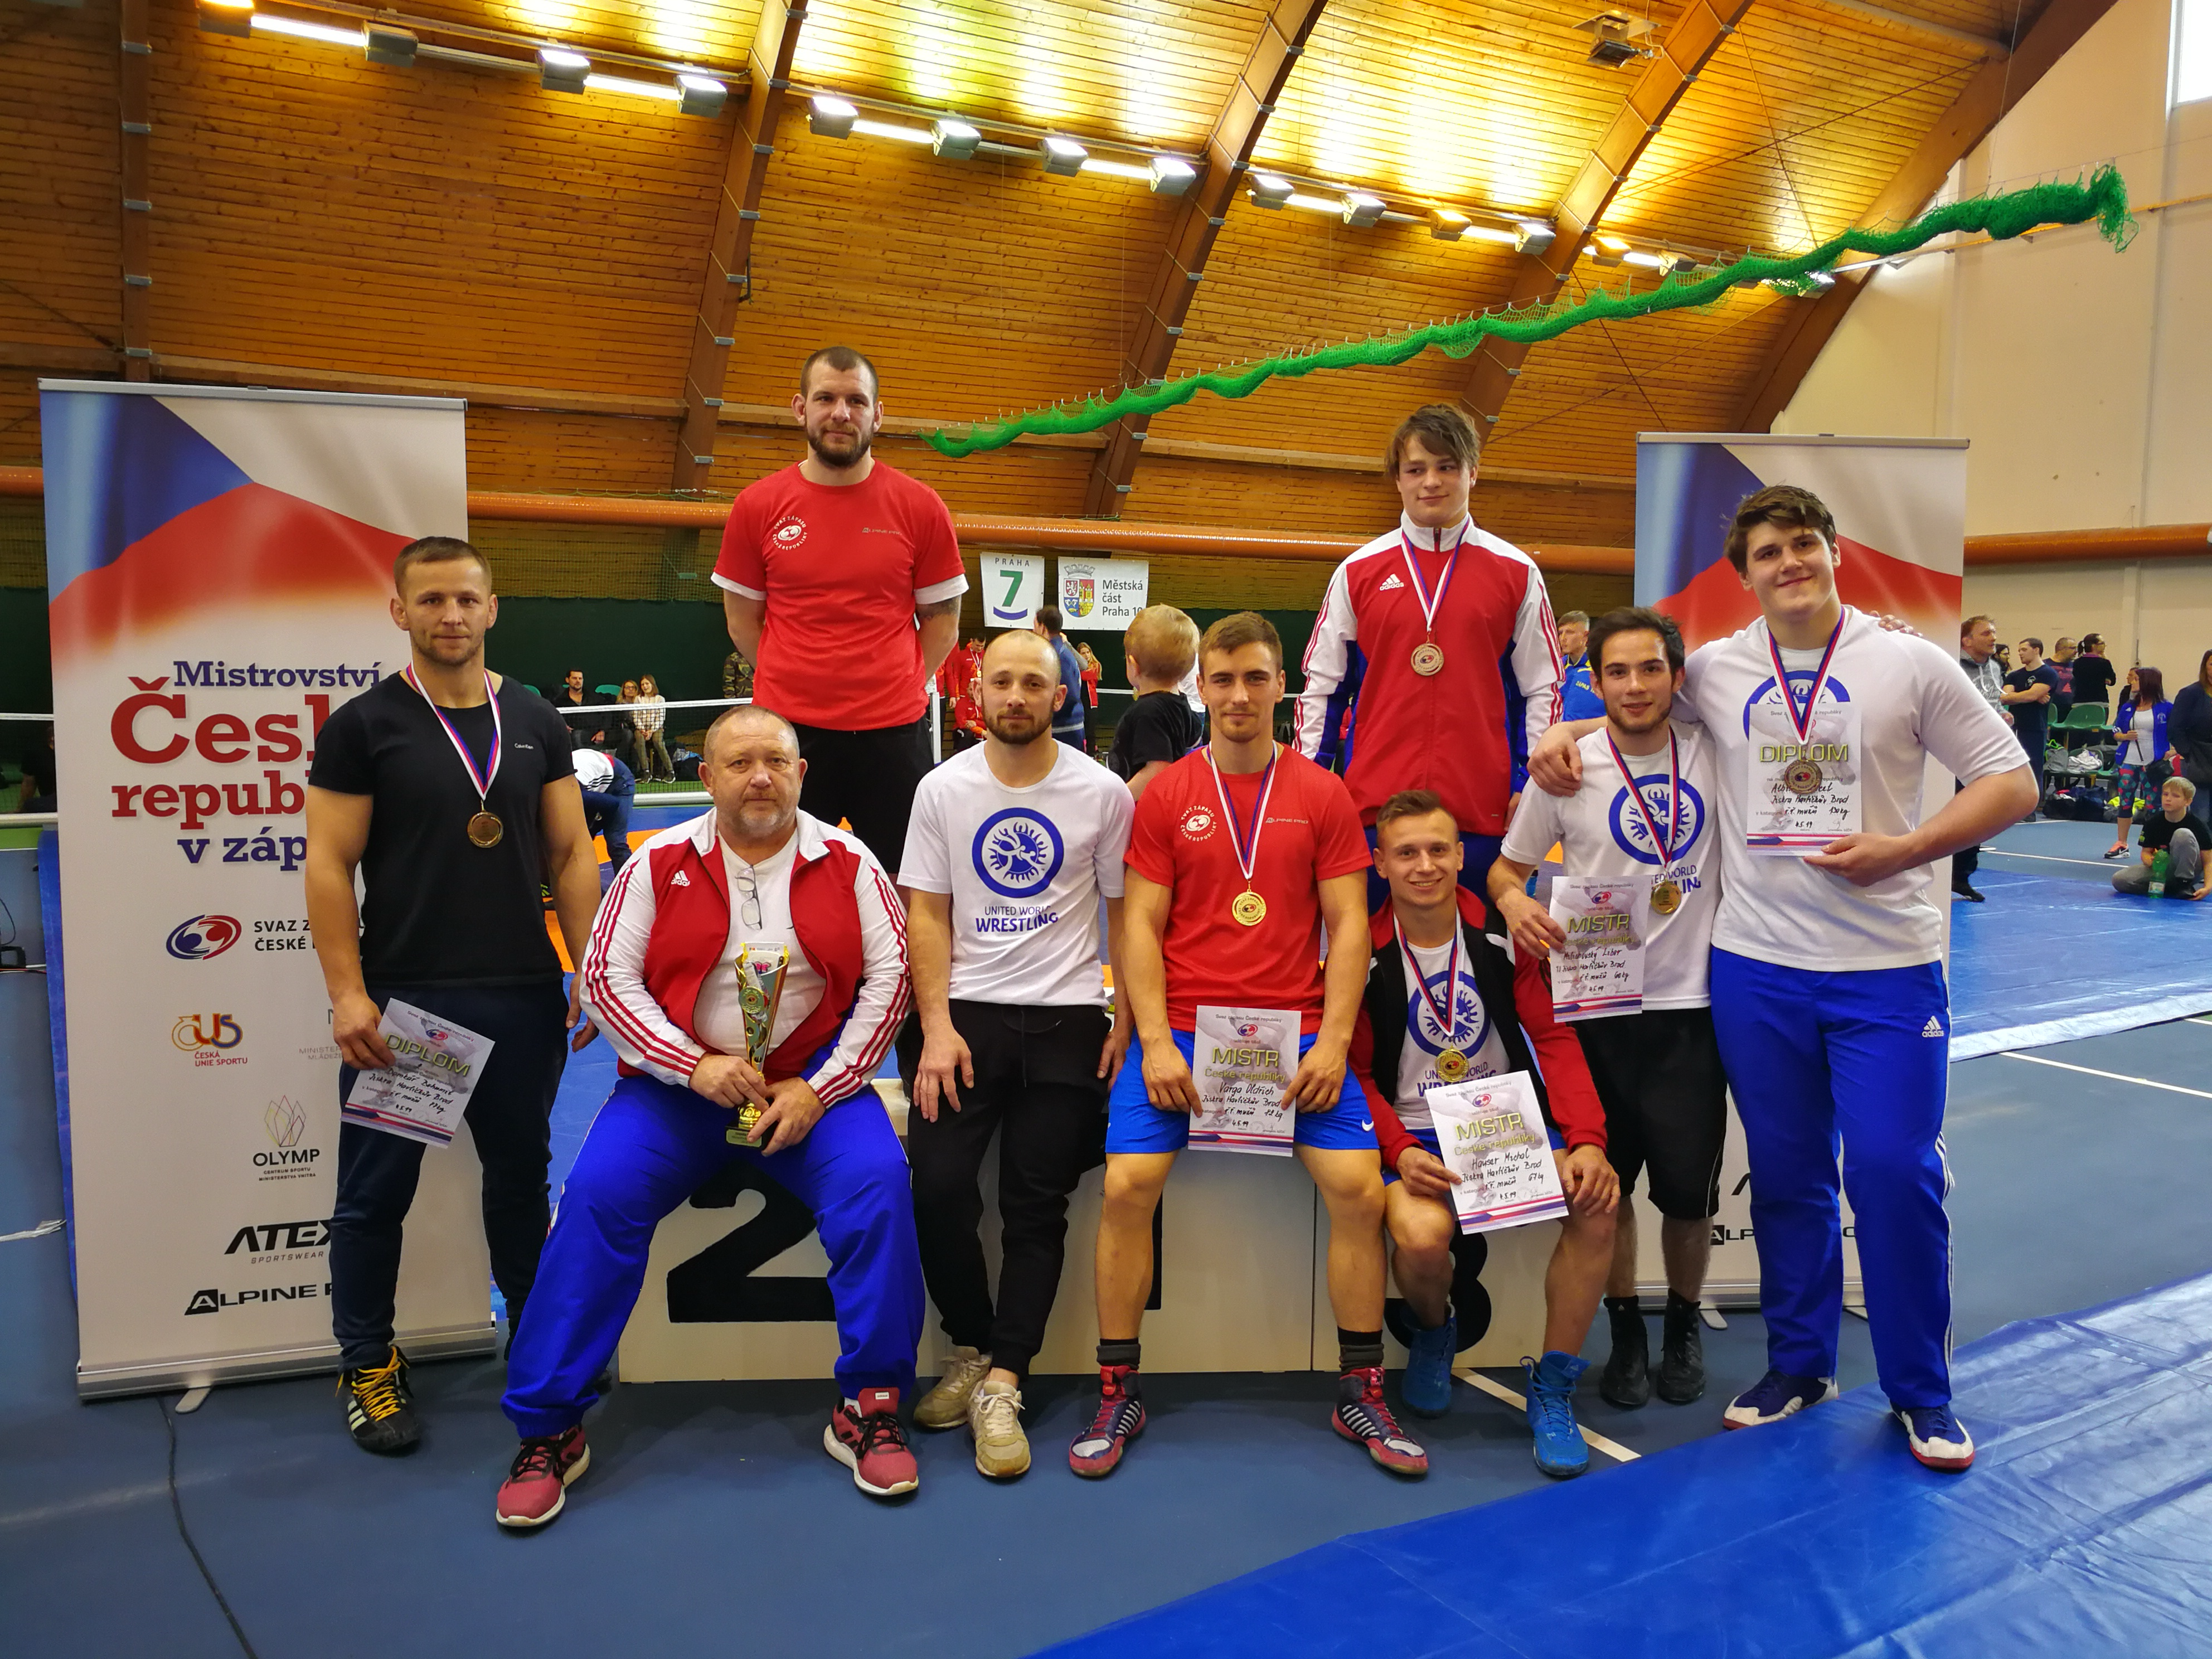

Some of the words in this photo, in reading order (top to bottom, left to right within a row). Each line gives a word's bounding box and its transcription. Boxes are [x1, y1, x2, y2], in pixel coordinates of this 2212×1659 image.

[995, 557, 1030, 567] PRAHA
[1000, 570, 1023, 607] 7
[1102, 579, 1143, 590] Městská
[1379, 581, 1404, 591] adidas
[1102, 592, 1122, 603] část
[1102, 605, 1129, 617] Praha
[173, 660, 381, 688] Mistrovství
[1760, 744, 1849, 763] DIPLOM
[111, 770, 310, 830] repub
[1831, 794, 1850, 803] Brod
[177, 838, 210, 864] v
[222, 827, 307, 871] záp
[984, 906, 1017, 916] UNITED
[254, 920, 297, 933] SVAZ
[976, 912, 1059, 933] WRESTLING
[1567, 914, 1631, 934] MISTR
[255, 935, 307, 951] ČESKÉ
[1610, 960, 1626, 968] Brod
[194, 1050, 220, 1060] ČESKÁ
[299, 1046, 341, 1054] MINISTER
[384, 1033, 472, 1078] DIPLOM
[216, 1057, 248, 1066] SPORTU
[1212, 1047, 1279, 1068] MISTR
[1204, 1066, 1236, 1079] České
[1239, 1070, 1286, 1084] republiky
[1246, 1083, 1275, 1096] Oldřich
[434, 1093, 454, 1105] Brod
[1262, 1097, 1282, 1108] Brod
[1454, 1112, 1524, 1141] MISTR
[1488, 1133, 1536, 1150] republiky
[253, 1148, 321, 1167] OLYMP
[1472, 1157, 1500, 1171] Hauser
[1524, 1159, 1542, 1170] Brod
[224, 1219, 332, 1255] ATEX
[667, 1161, 837, 1323] 2
[250, 1250, 324, 1264] SPORTSWEAR
[184, 1284, 318, 1316] ALPINE
